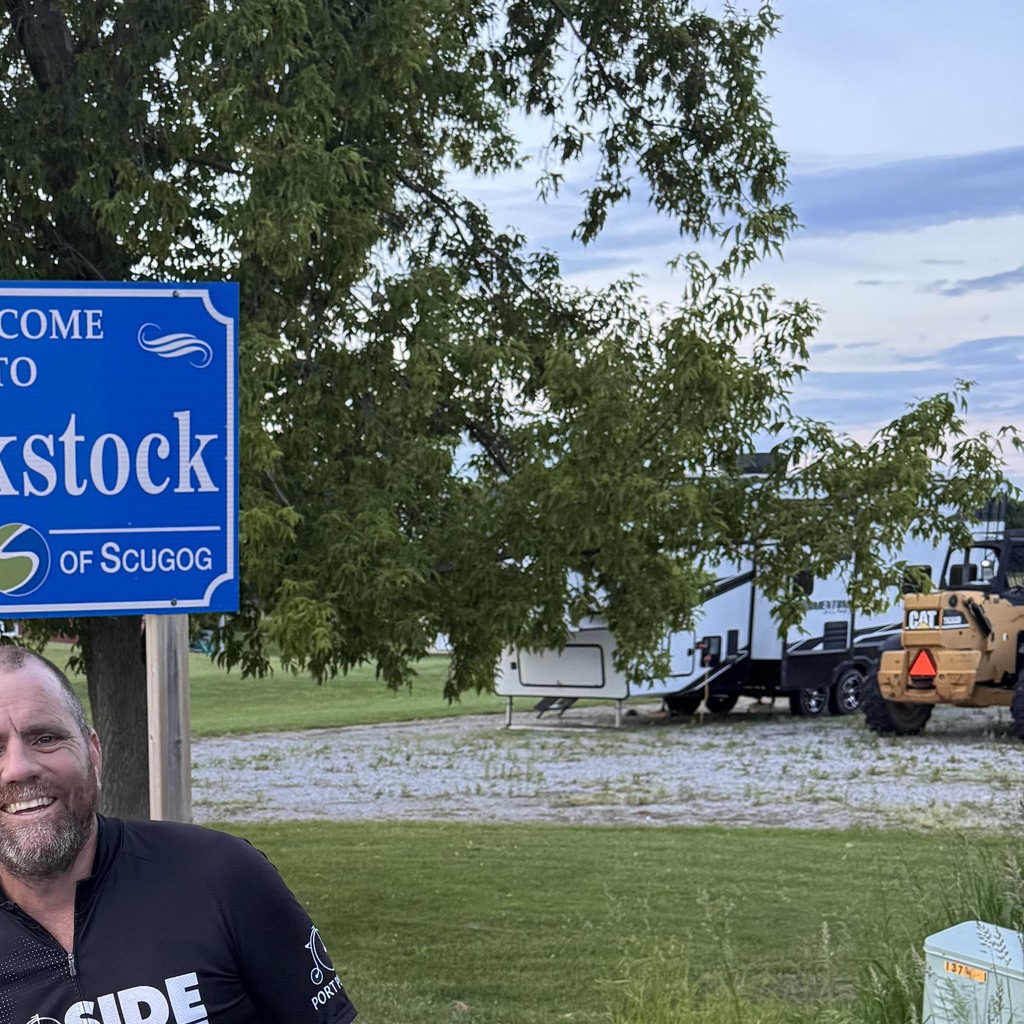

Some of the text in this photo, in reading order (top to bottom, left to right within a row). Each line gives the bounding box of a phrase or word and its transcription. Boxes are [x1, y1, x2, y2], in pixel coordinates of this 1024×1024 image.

[59, 547, 94, 575] OF
[100, 541, 213, 574] SCUGOG
[908, 609, 938, 630] CAT
[311, 979, 338, 1011] PORT
